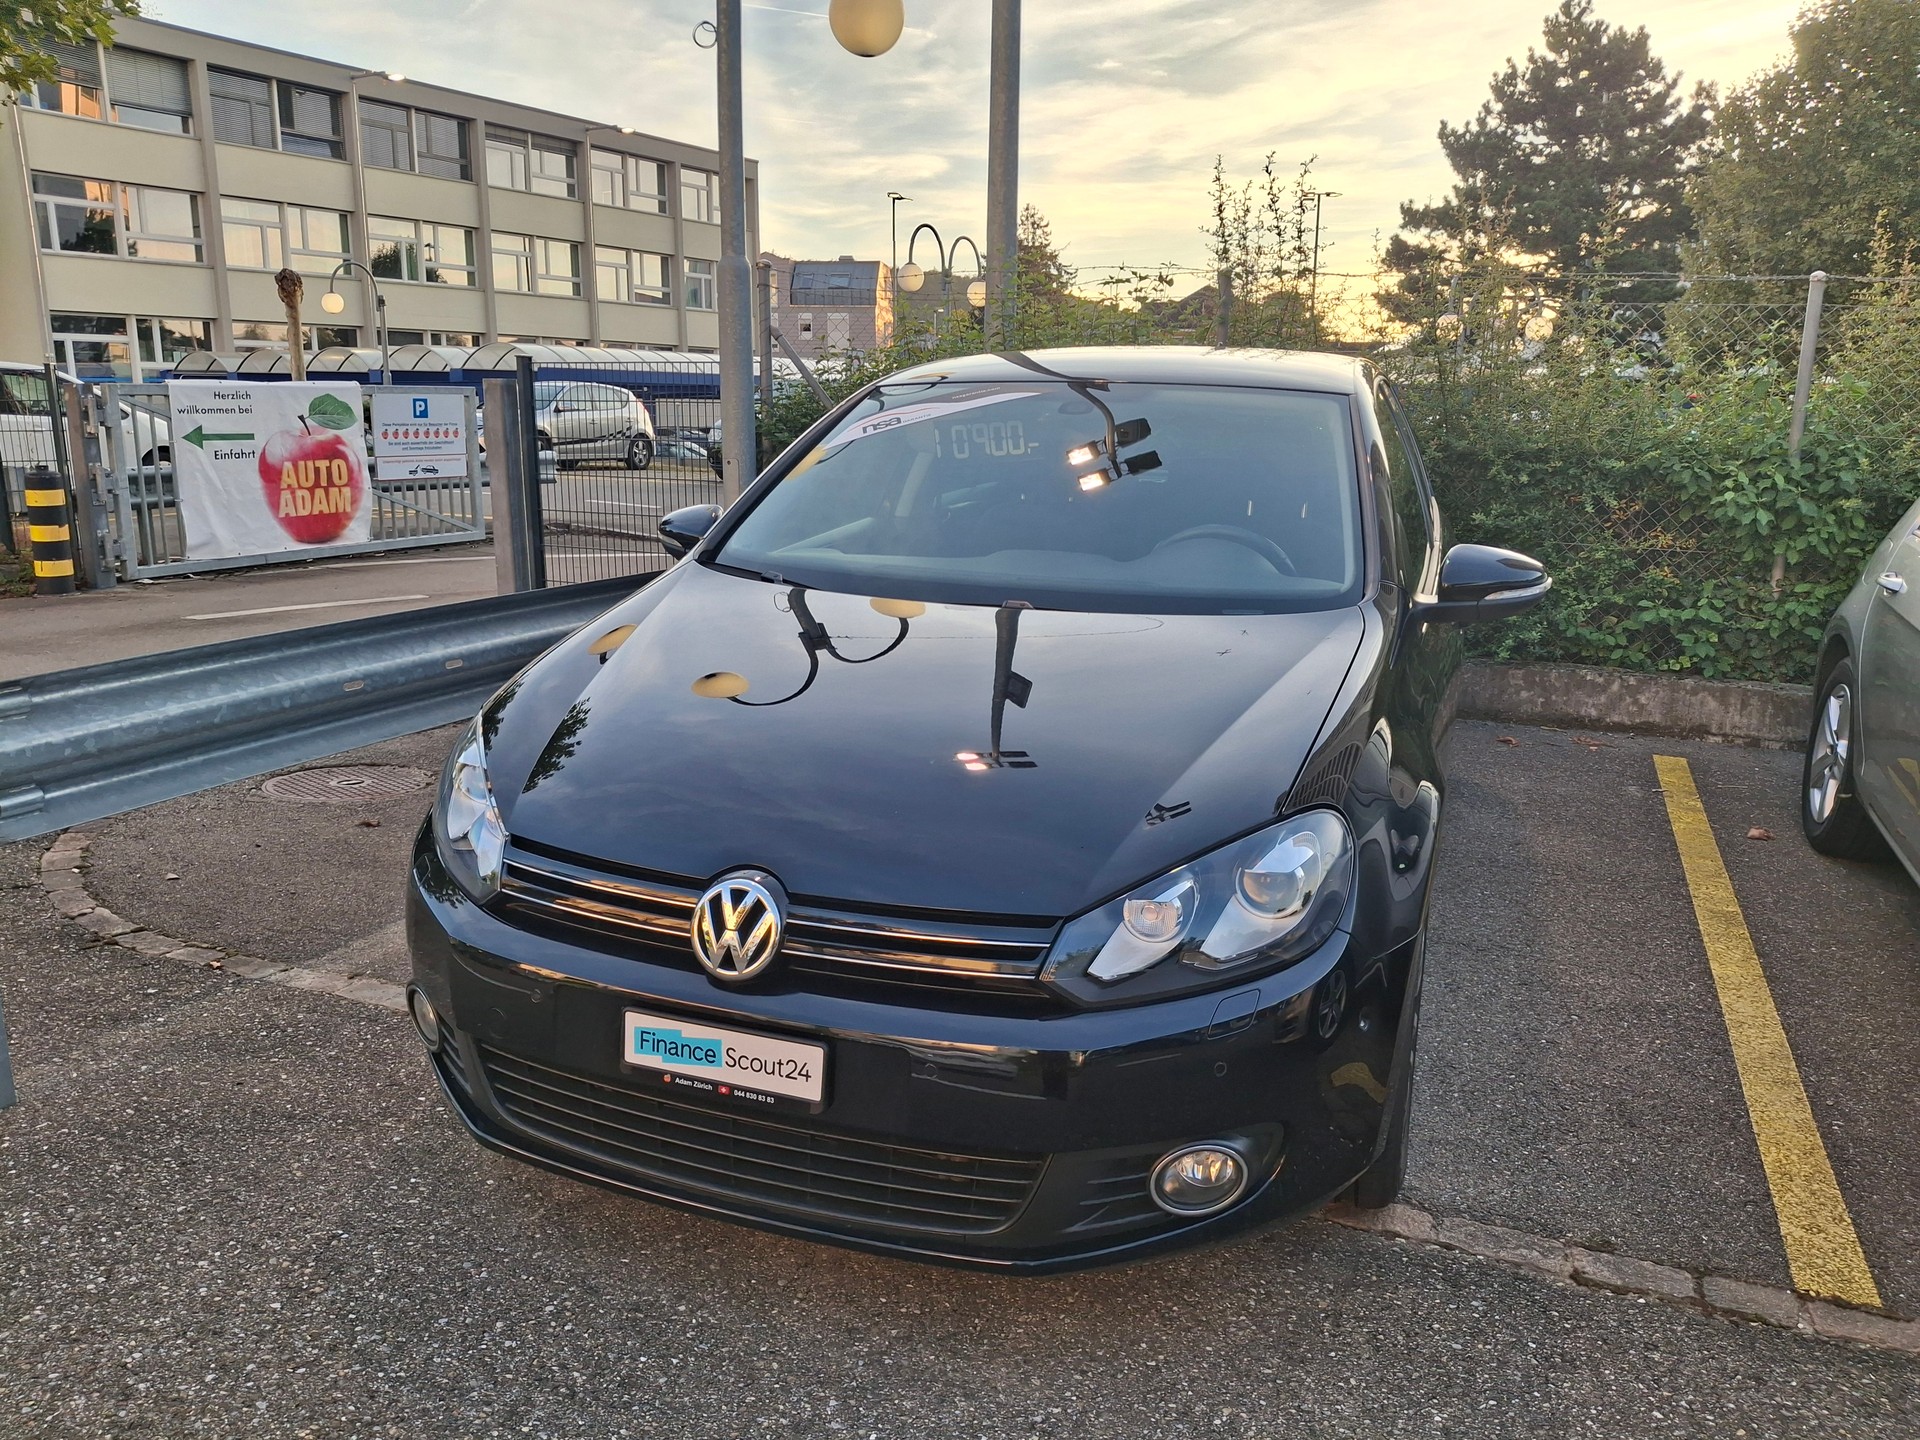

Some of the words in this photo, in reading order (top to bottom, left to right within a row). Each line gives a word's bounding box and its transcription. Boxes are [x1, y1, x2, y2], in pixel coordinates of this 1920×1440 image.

[213, 391, 252, 400] Herzlich
[177, 405, 236, 415] willkommen
[238, 404, 253, 414] bei
[415, 400, 426, 416] P
[862, 416, 902, 434] nsa
[214, 449, 256, 460] Einfahrt
[280, 458, 349, 489] AUTO
[278, 486, 352, 518] ADAM
[695, 880, 778, 979] VW
[675, 1077, 693, 1087] Adam
[693, 1080, 713, 1091] Zürich
[733, 1089, 745, 1097] 044
[745, 1092, 757, 1100] 830
[757, 1094, 766, 1102] 83
[766, 1096, 775, 1104] 83
